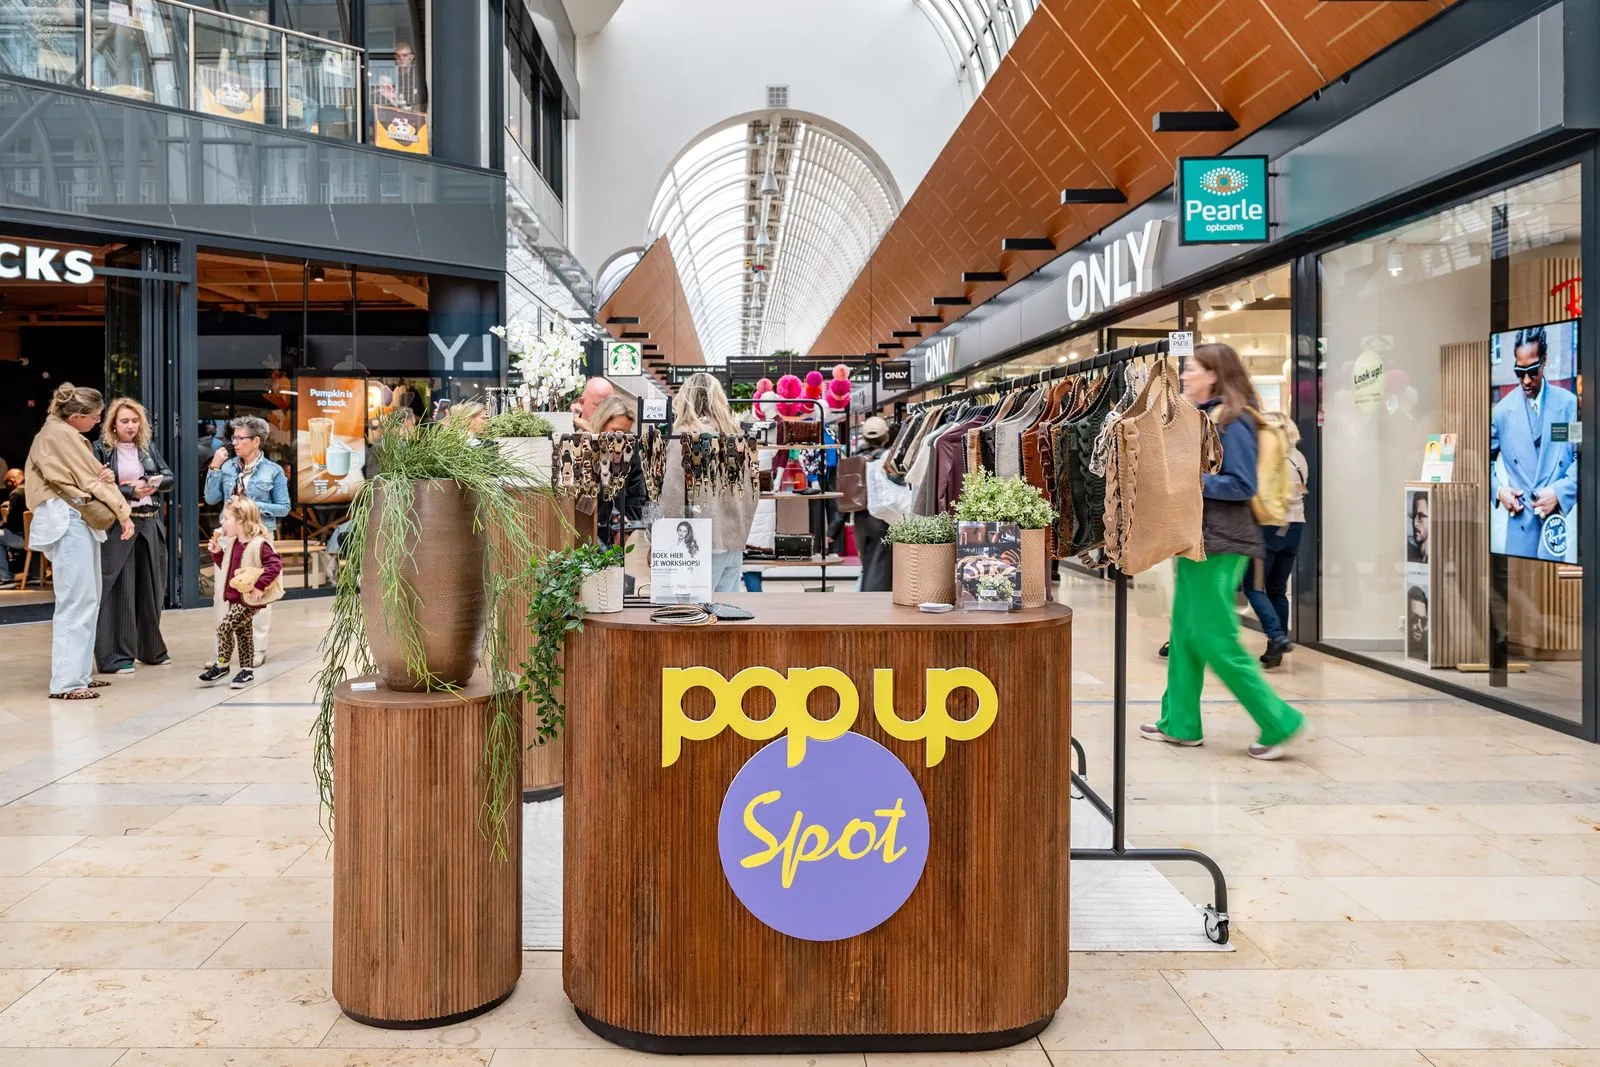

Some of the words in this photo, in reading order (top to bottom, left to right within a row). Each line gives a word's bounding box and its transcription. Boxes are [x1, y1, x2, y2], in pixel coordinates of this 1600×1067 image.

[1186, 199, 1263, 221] Pearle
[1206, 223, 1244, 233] opticiens
[1067, 219, 1157, 320] ONLY
[925, 336, 952, 381] ONLY
[884, 371, 908, 380] ONLY
[1354, 369, 1370, 384] Look
[1371, 364, 1383, 379] up!
[310, 388, 345, 398] Pumpkin
[346, 390, 353, 398] is
[327, 399, 346, 407] back
[662, 666, 860, 768] pop
[873, 666, 999, 768] up
[739, 790, 907, 889] Spot
